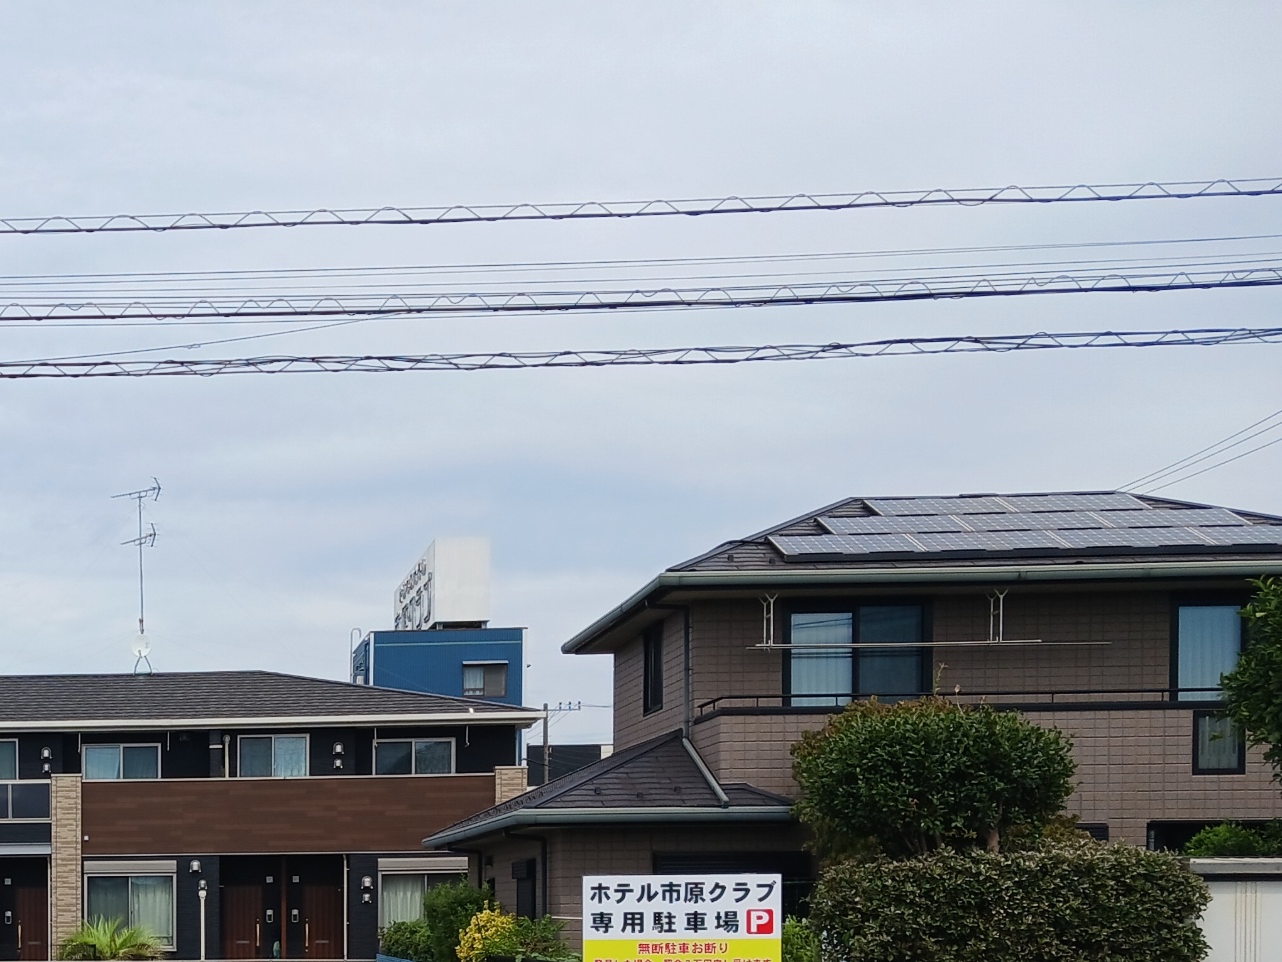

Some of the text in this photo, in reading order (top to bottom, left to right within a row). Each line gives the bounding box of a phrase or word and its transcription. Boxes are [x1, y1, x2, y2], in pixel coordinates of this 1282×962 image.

[590, 880, 777, 904] ホテル市原クラブ
[590, 910, 770, 933] 専用駐車場 P
[638, 942, 728, 954] 無断駐車お断り
